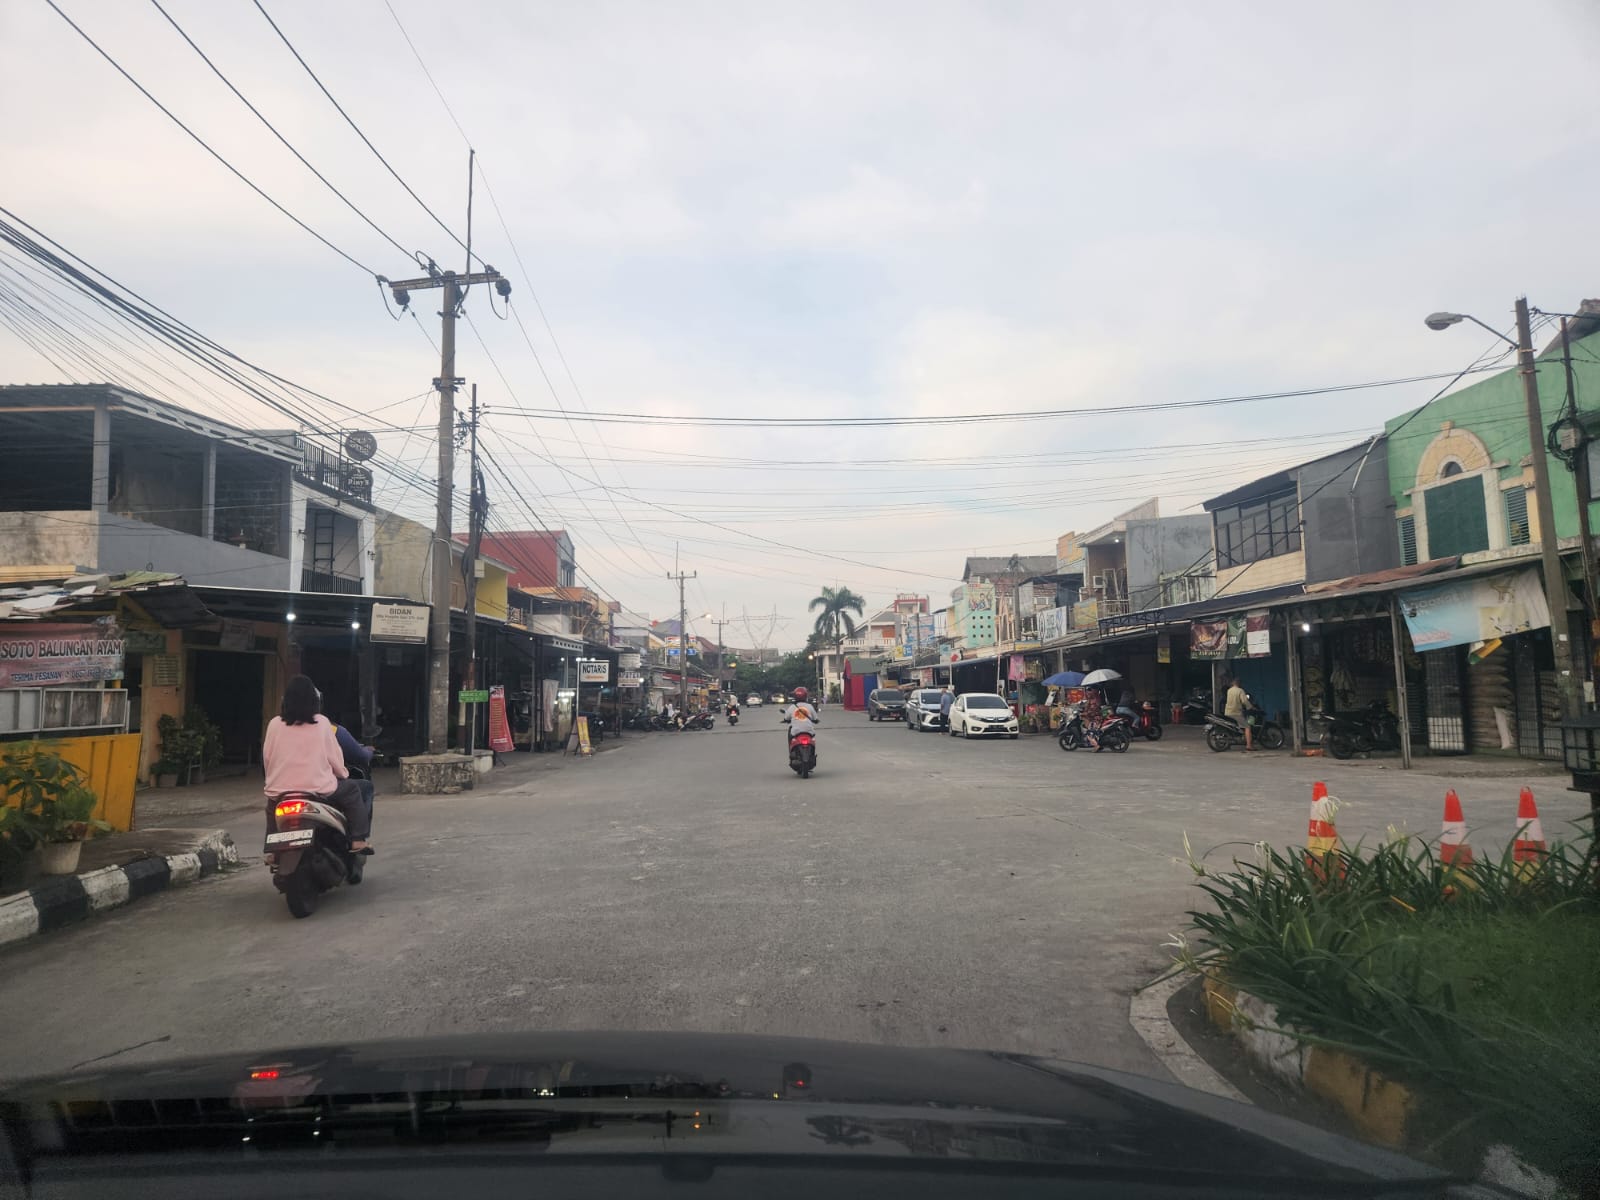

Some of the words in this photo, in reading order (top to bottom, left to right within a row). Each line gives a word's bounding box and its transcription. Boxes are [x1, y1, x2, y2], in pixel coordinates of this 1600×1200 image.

[0, 641, 35, 659] SOTO
[39, 640, 93, 657] BALUNGAN
[96, 640, 122, 656] AYAM
[582, 664, 607, 674] NOTARIS
